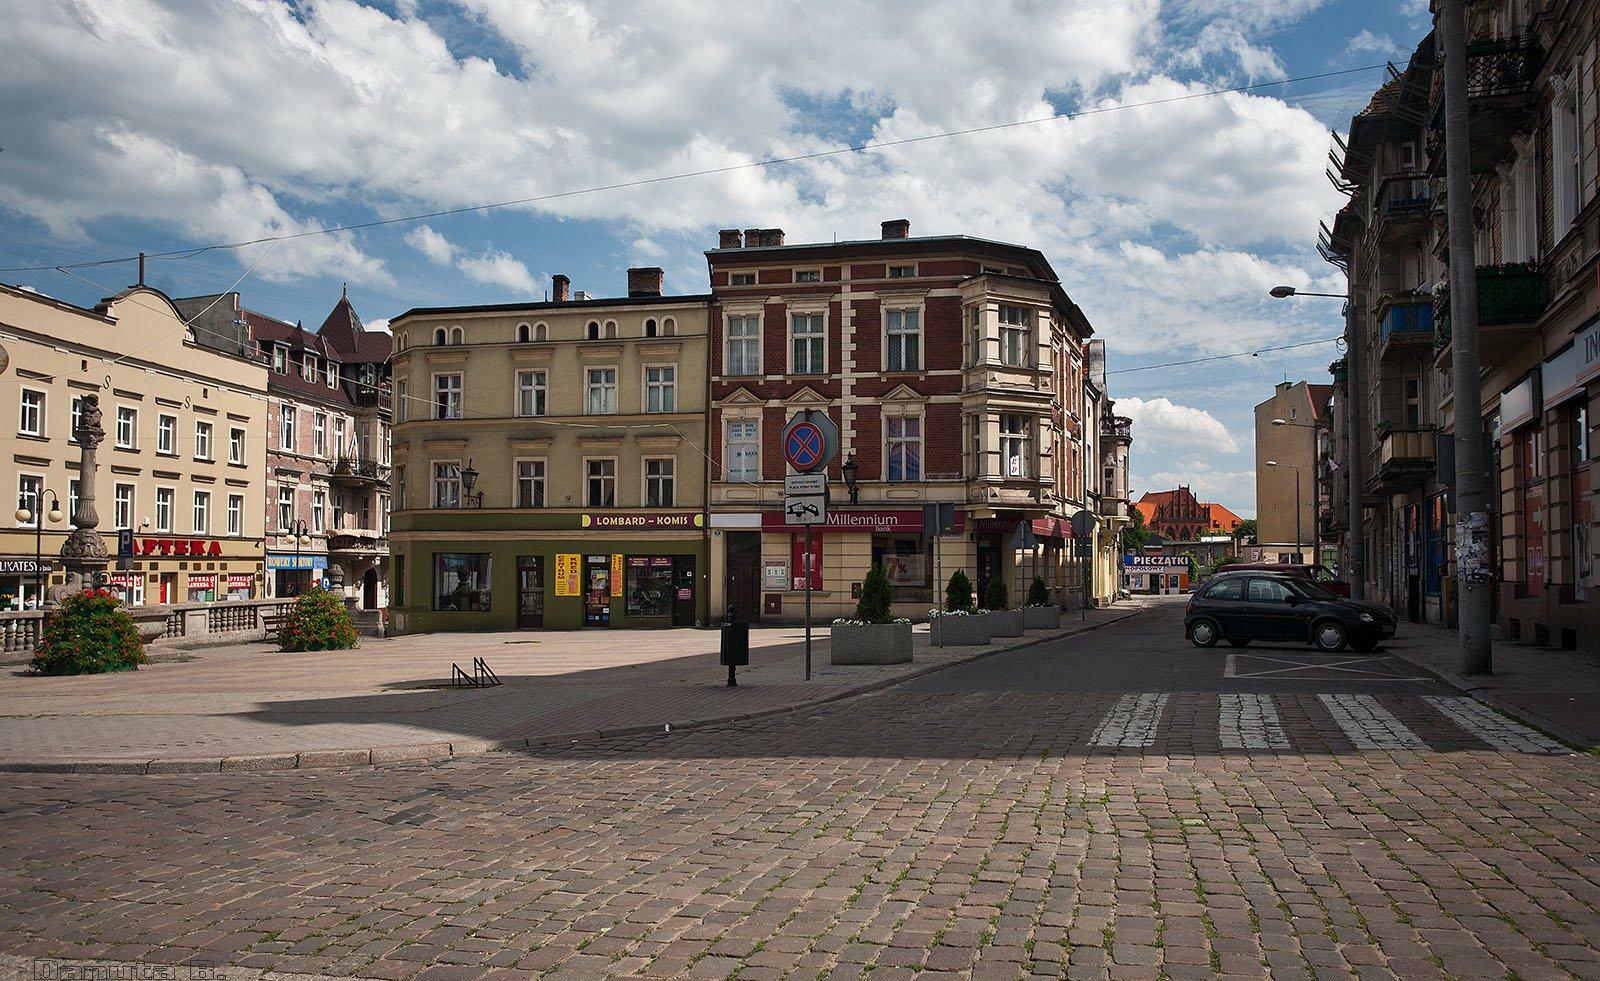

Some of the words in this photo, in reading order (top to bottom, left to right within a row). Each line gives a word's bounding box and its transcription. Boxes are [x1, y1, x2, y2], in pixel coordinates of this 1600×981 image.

[1584, 329, 1600, 364] IN
[596, 516, 646, 526] LOMBARD
[656, 515, 689, 525] KOMIS
[827, 511, 898, 525] Millennium
[121, 532, 130, 550] P
[1133, 556, 1189, 567] PIECZĄTKI
